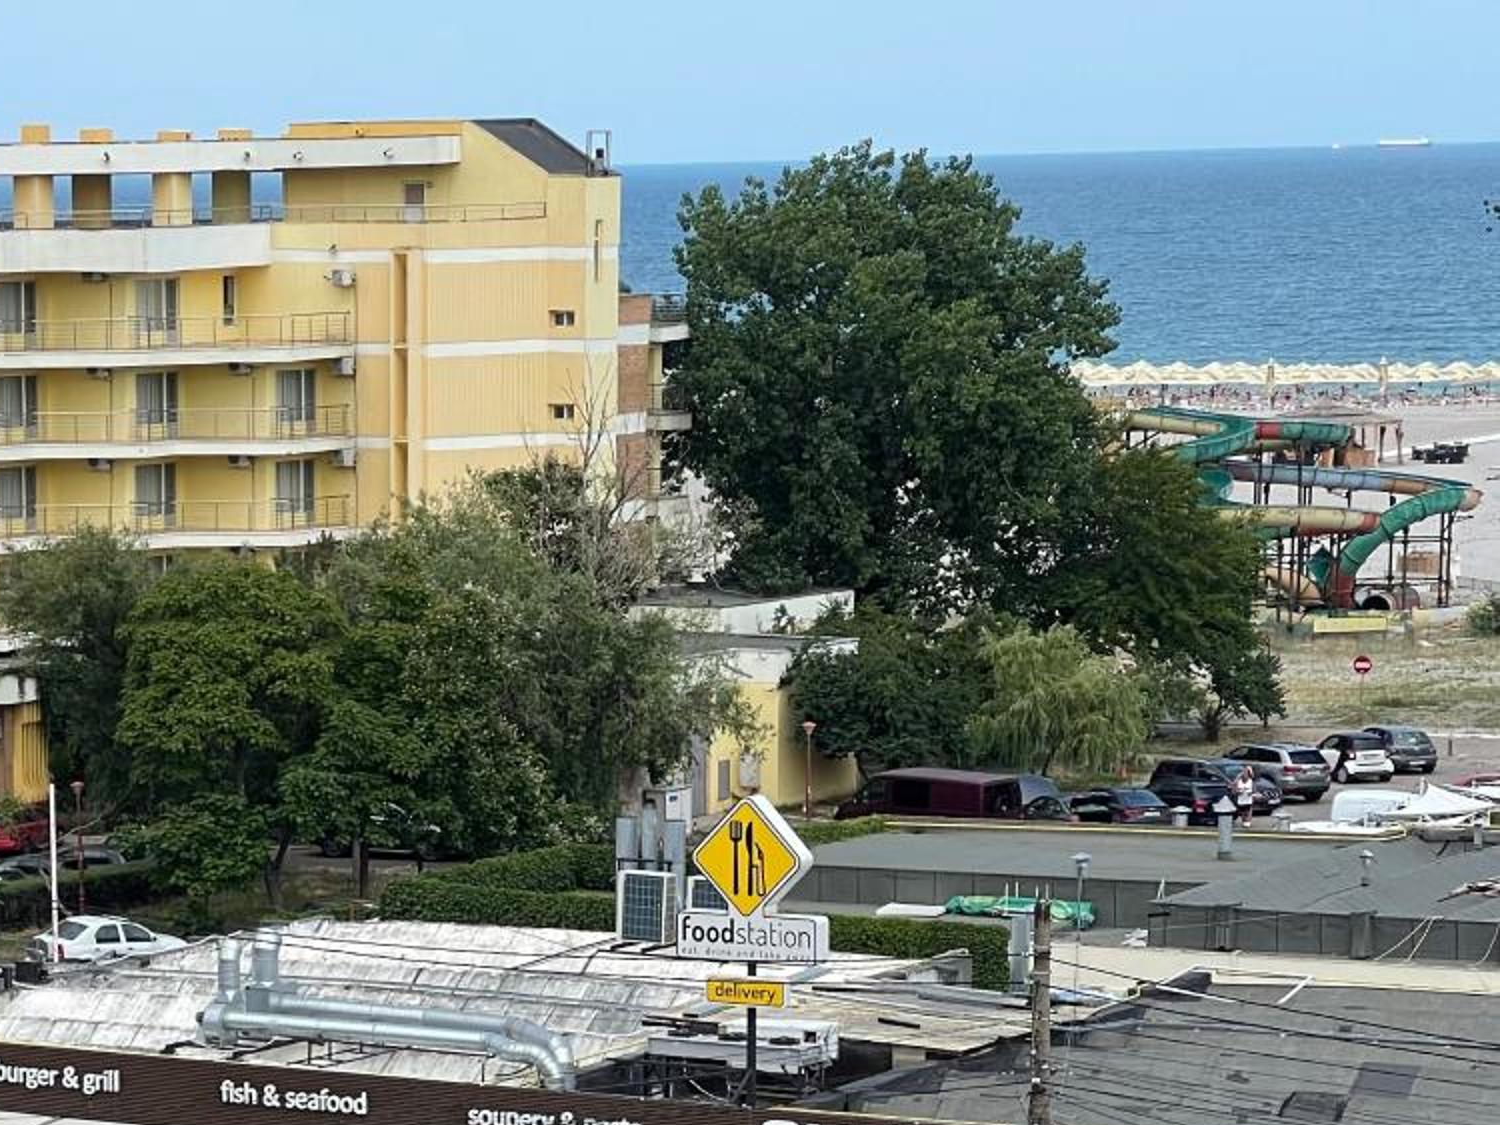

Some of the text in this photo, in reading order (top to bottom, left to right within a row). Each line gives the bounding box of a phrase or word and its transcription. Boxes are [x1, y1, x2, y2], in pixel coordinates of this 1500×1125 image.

[715, 982, 776, 1002] delivery
[62, 1066, 80, 1089] &
[83, 1069, 119, 1095] grill
[219, 1080, 368, 1115] fish & seafood
